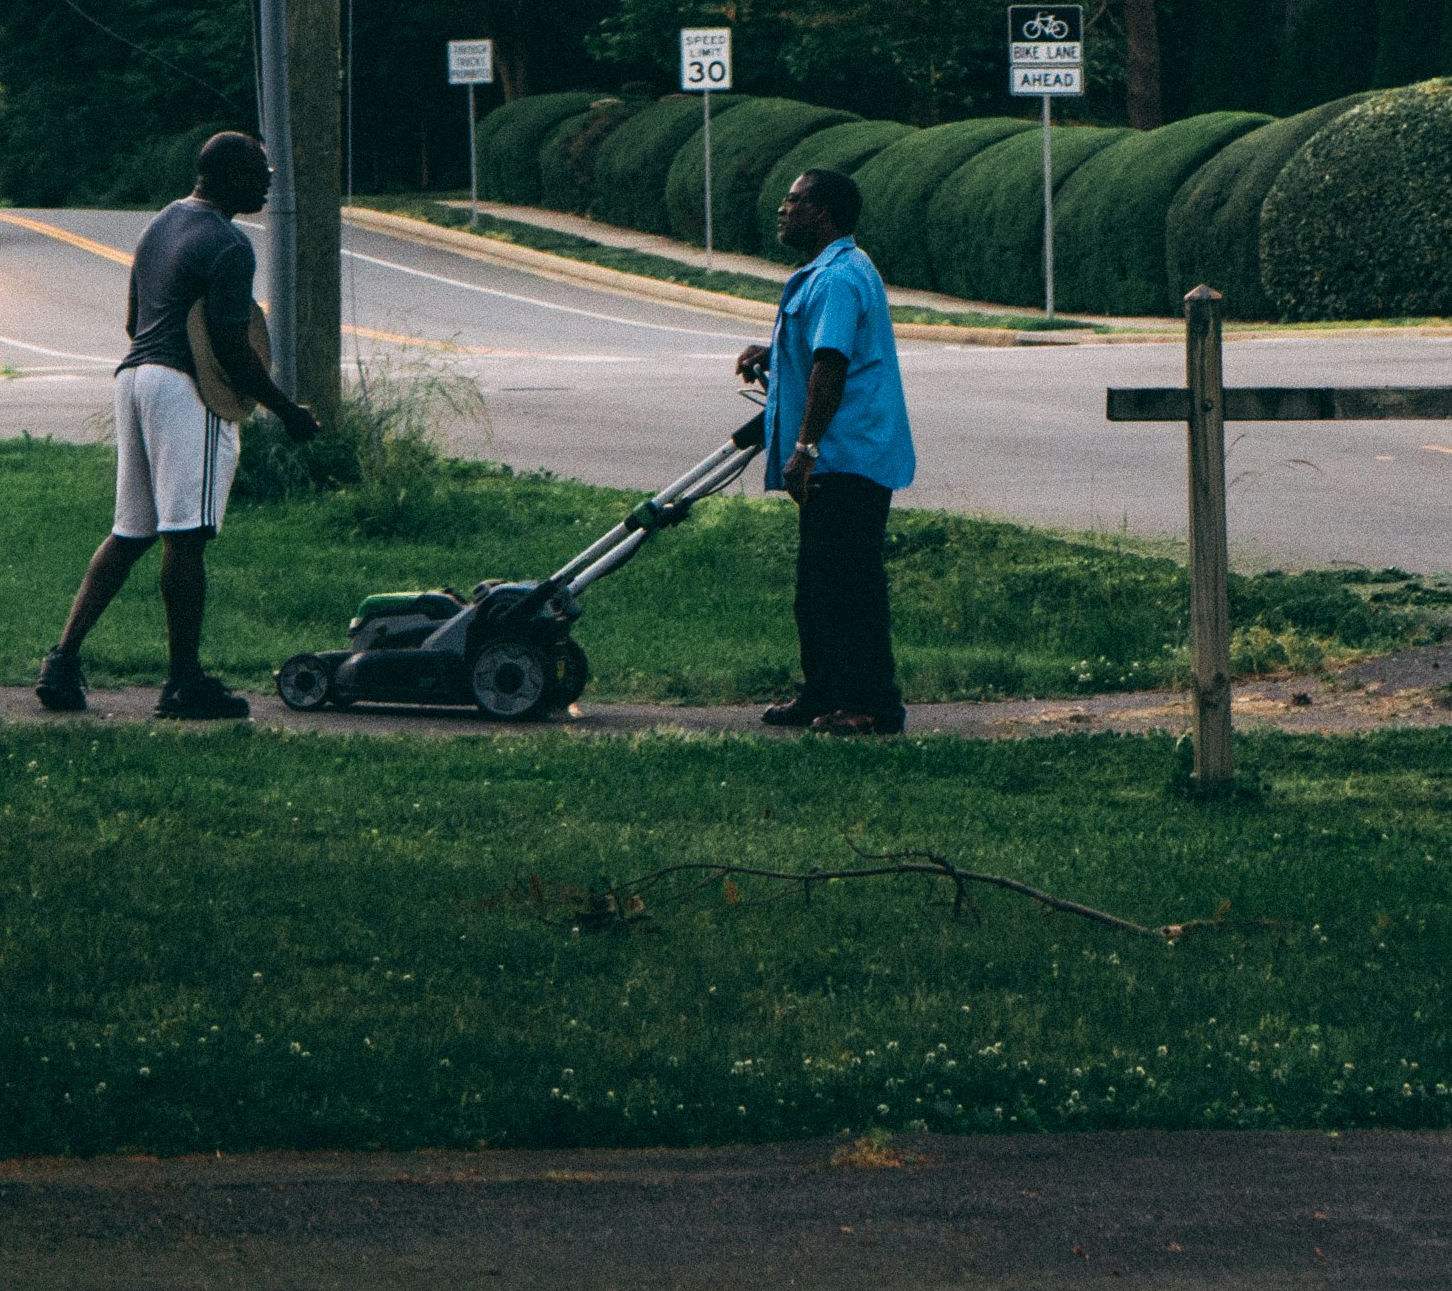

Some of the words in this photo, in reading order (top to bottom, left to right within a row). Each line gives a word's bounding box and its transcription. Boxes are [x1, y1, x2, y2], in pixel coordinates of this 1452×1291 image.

[685, 35, 726, 46] SPEED
[689, 47, 723, 58] LIMIT
[1013, 45, 1040, 60] BIKE
[1046, 45, 1078, 60] LANE
[688, 60, 726, 83] 30
[1021, 72, 1074, 87] AHEAD
